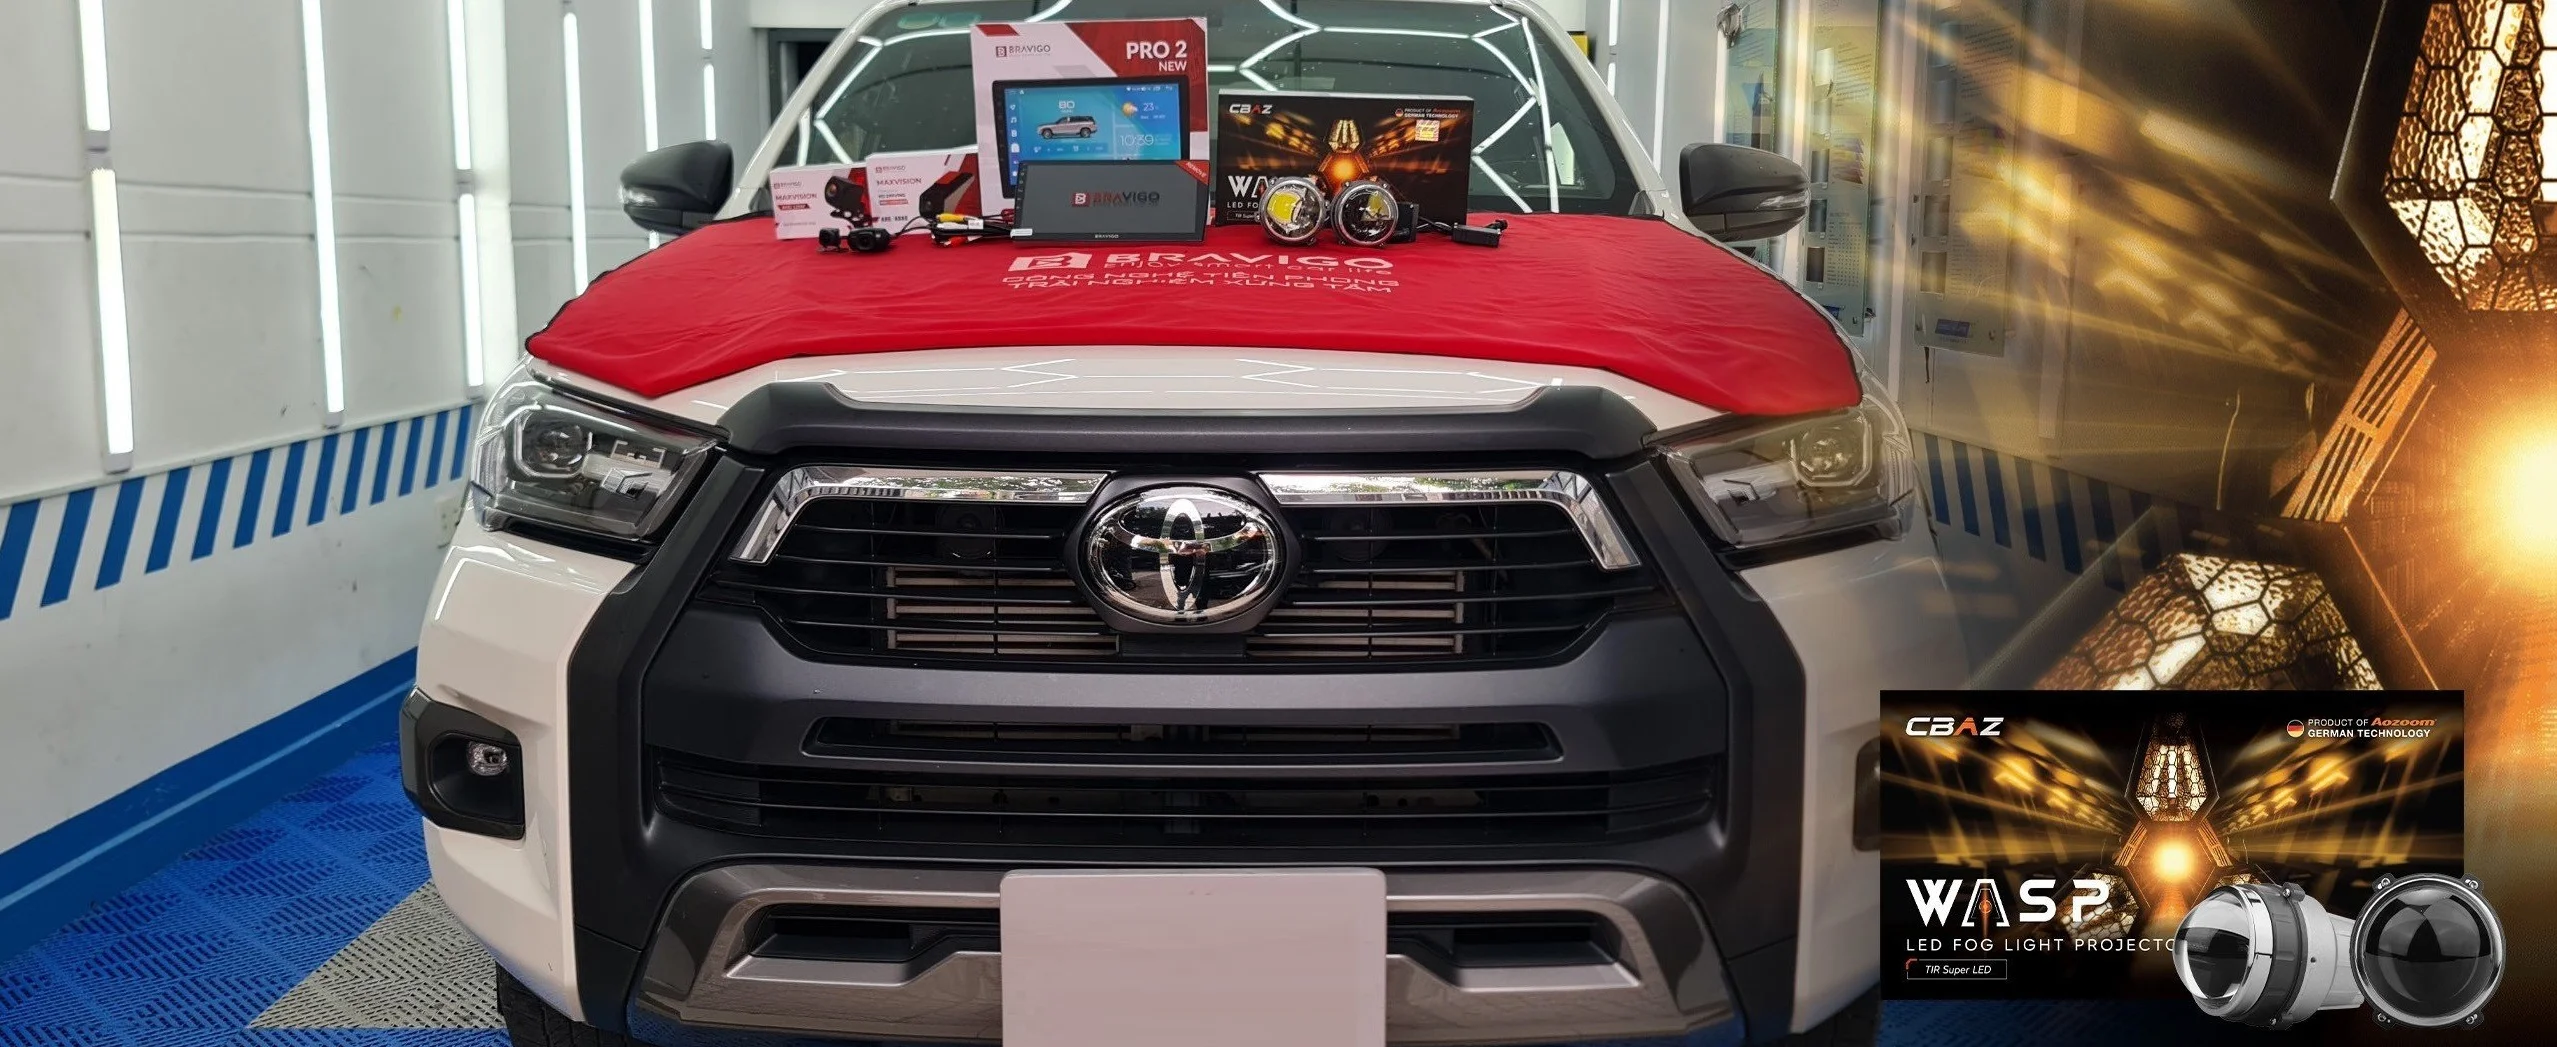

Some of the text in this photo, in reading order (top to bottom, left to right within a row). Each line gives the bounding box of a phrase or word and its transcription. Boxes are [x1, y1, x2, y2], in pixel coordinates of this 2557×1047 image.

[1008, 45, 1051, 54] BRAVIGO
[1125, 40, 1187, 59] PRO 2
[1158, 61, 1187, 72] NEW
[1228, 103, 1273, 115] CBAZ
[1120, 134, 1154, 147] 10:39
[876, 178, 922, 186] MAXVISION
[1228, 175, 1269, 198] WA
[1093, 191, 1160, 204] BRAVIGO
[1227, 201, 1259, 209] LED FO
[1106, 252, 1393, 269] BRAVIGO
[1284, 274, 1400, 287] PHONG
